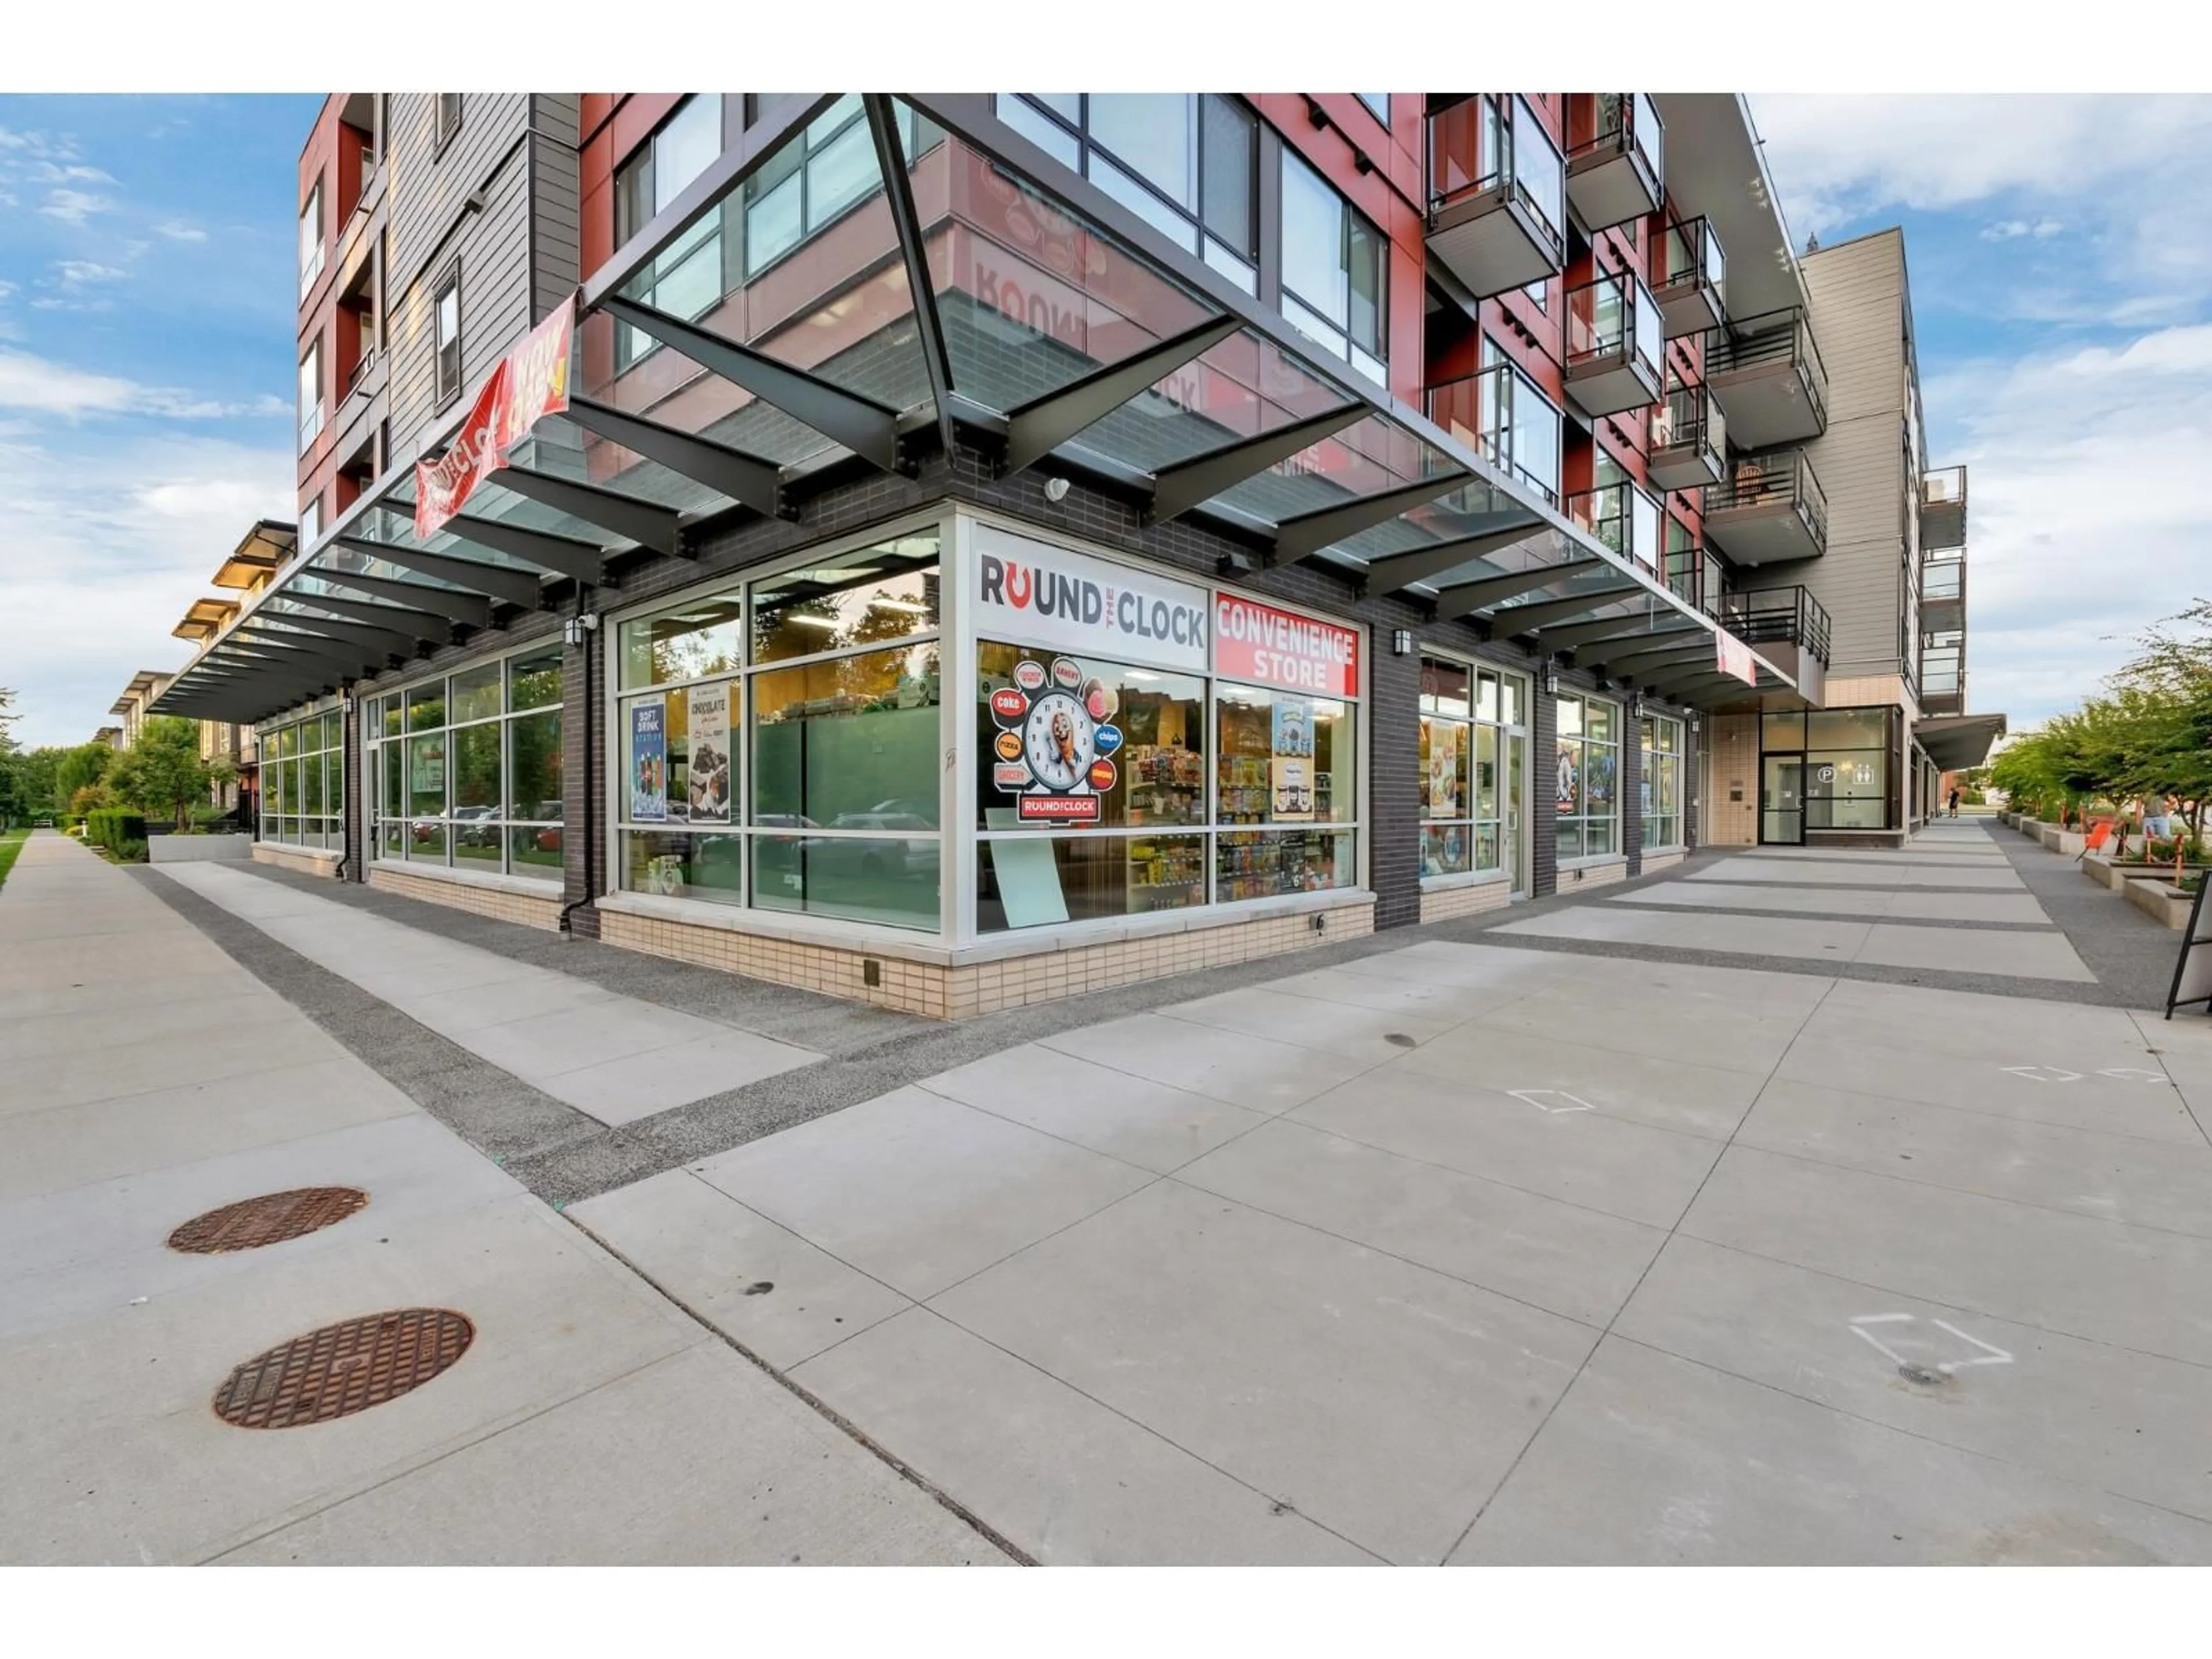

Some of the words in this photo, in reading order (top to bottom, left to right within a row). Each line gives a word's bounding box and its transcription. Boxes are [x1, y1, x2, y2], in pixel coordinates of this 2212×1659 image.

[982, 554, 1102, 624] ROUND
[1118, 592, 1204, 649] CLOCK
[1217, 600, 1353, 665] CONVENIENCE
[1254, 650, 1327, 688] STORE
[639, 710, 656, 721] SOFT
[637, 719, 659, 733] DRINK
[1823, 770, 1831, 780] P
[1025, 801, 1060, 811] ROUND
[1065, 801, 1094, 811] CLOCK
